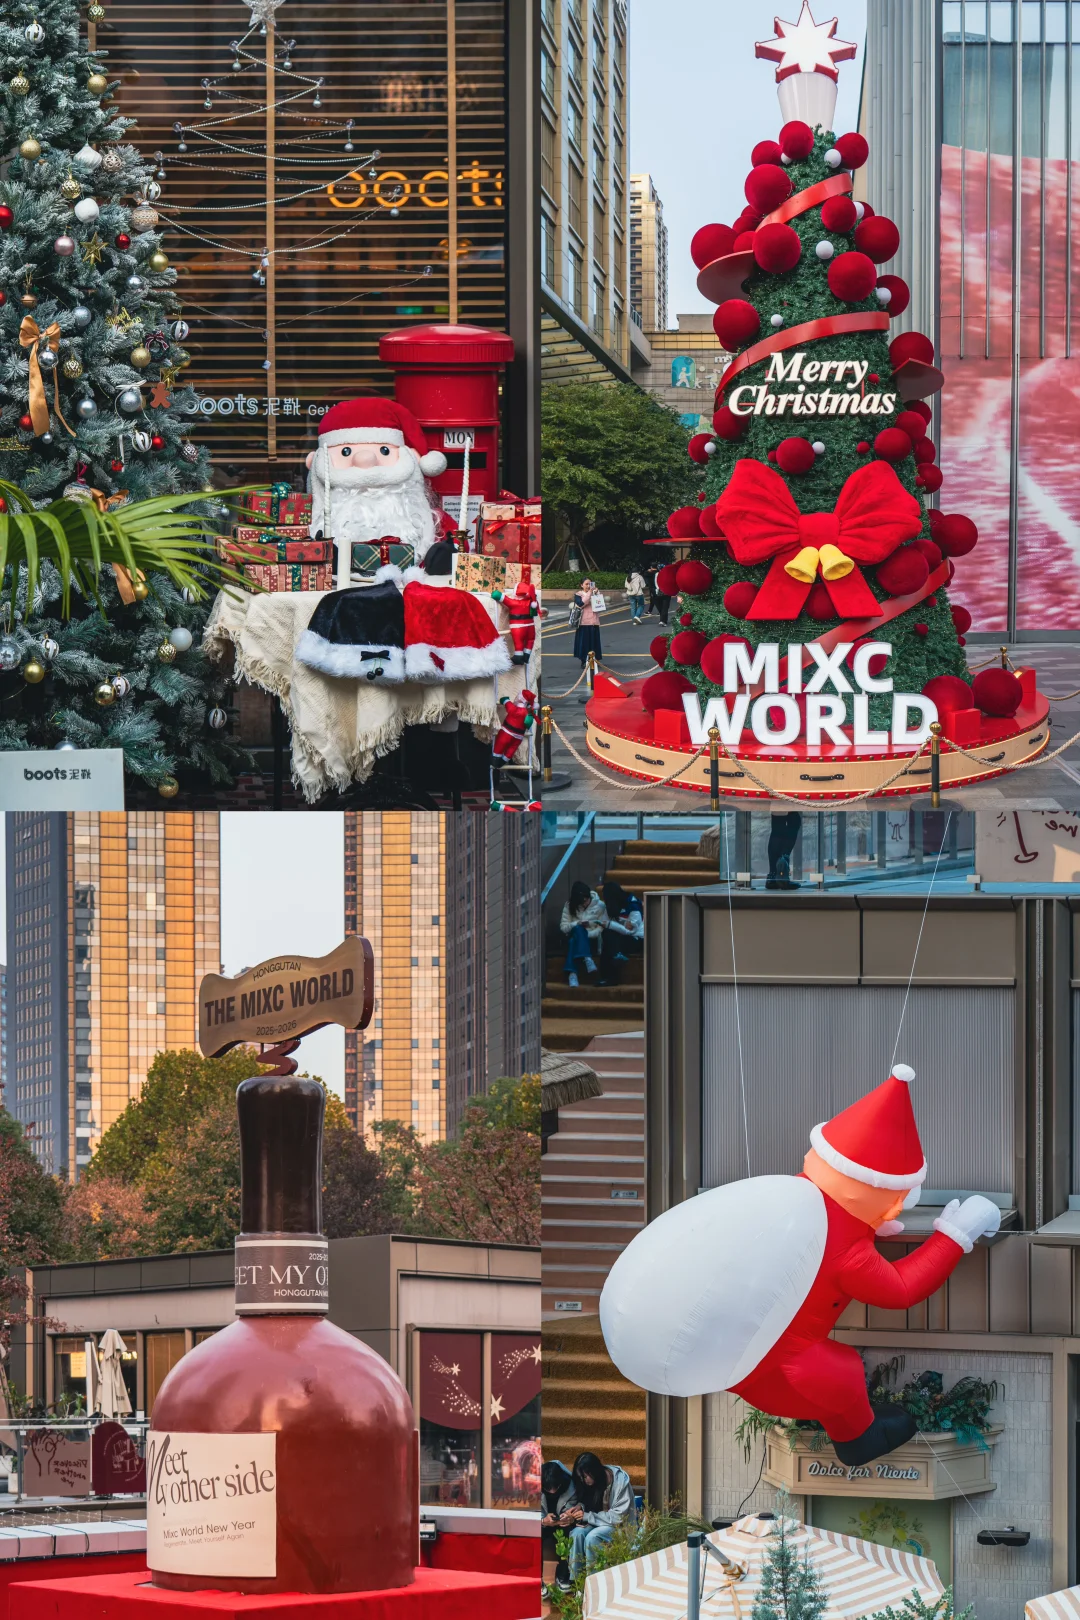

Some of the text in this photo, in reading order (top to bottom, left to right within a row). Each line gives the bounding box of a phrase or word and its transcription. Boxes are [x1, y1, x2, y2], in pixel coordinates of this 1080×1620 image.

[765, 352, 869, 390] Merry
[728, 384, 896, 416] Christmas
[445, 431, 474, 444] MON
[723, 642, 894, 694] MIXC
[681, 692, 939, 746] WORLD
[23, 767, 67, 781] boots
[252, 961, 302, 981] HONGGUTAN
[204, 968, 354, 1027] THE MIXC WORLD
[255, 1019, 297, 1036] 2025-2026
[269, 1265, 311, 1285] MY
[807, 1461, 843, 1476] Dolce
[875, 1464, 920, 1480] Niente
[170, 1469, 221, 1504] other
[224, 1460, 275, 1497] side
[180, 1525, 204, 1537] World
[206, 1523, 228, 1534] New
[231, 1520, 256, 1531] Year
